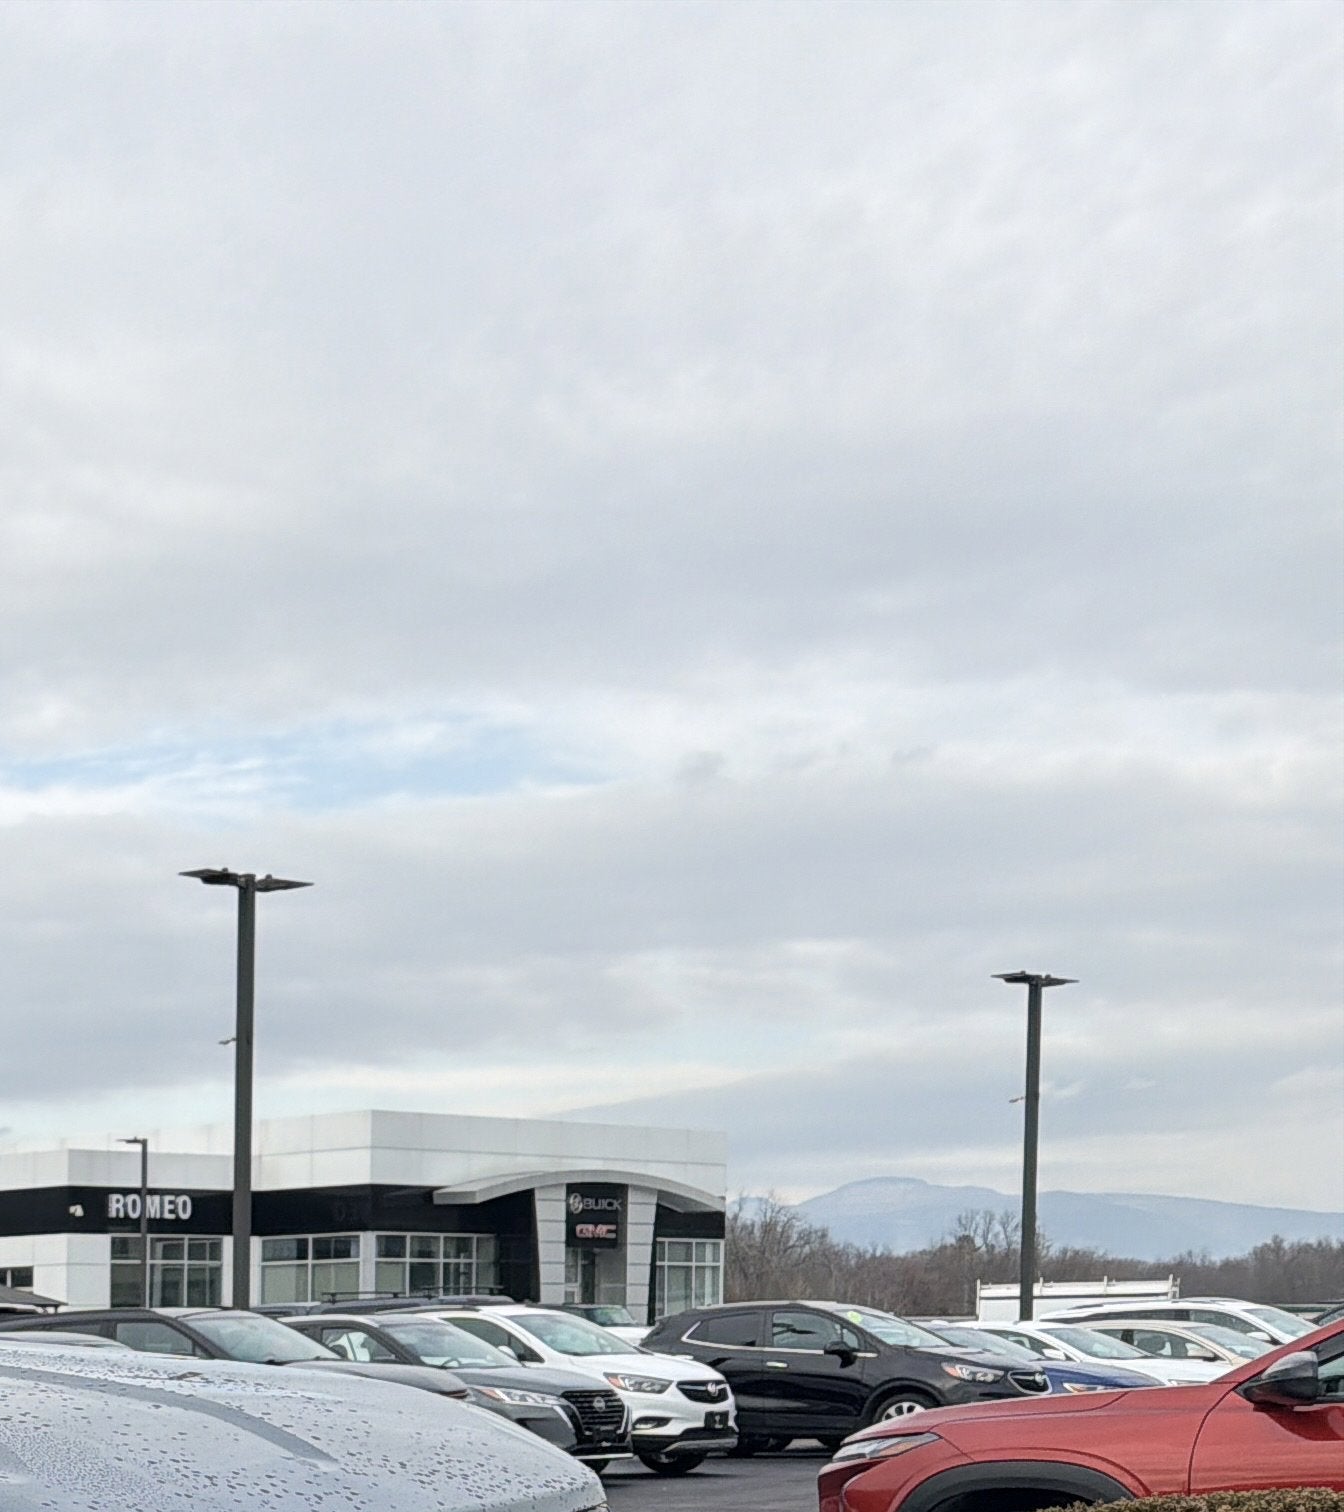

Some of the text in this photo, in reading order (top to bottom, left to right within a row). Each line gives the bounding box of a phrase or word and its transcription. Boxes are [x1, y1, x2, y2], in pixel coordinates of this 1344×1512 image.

[108, 1194, 192, 1220] ROMEO
[583, 1198, 622, 1211] BUICK
[576, 1224, 617, 1239] GMC
